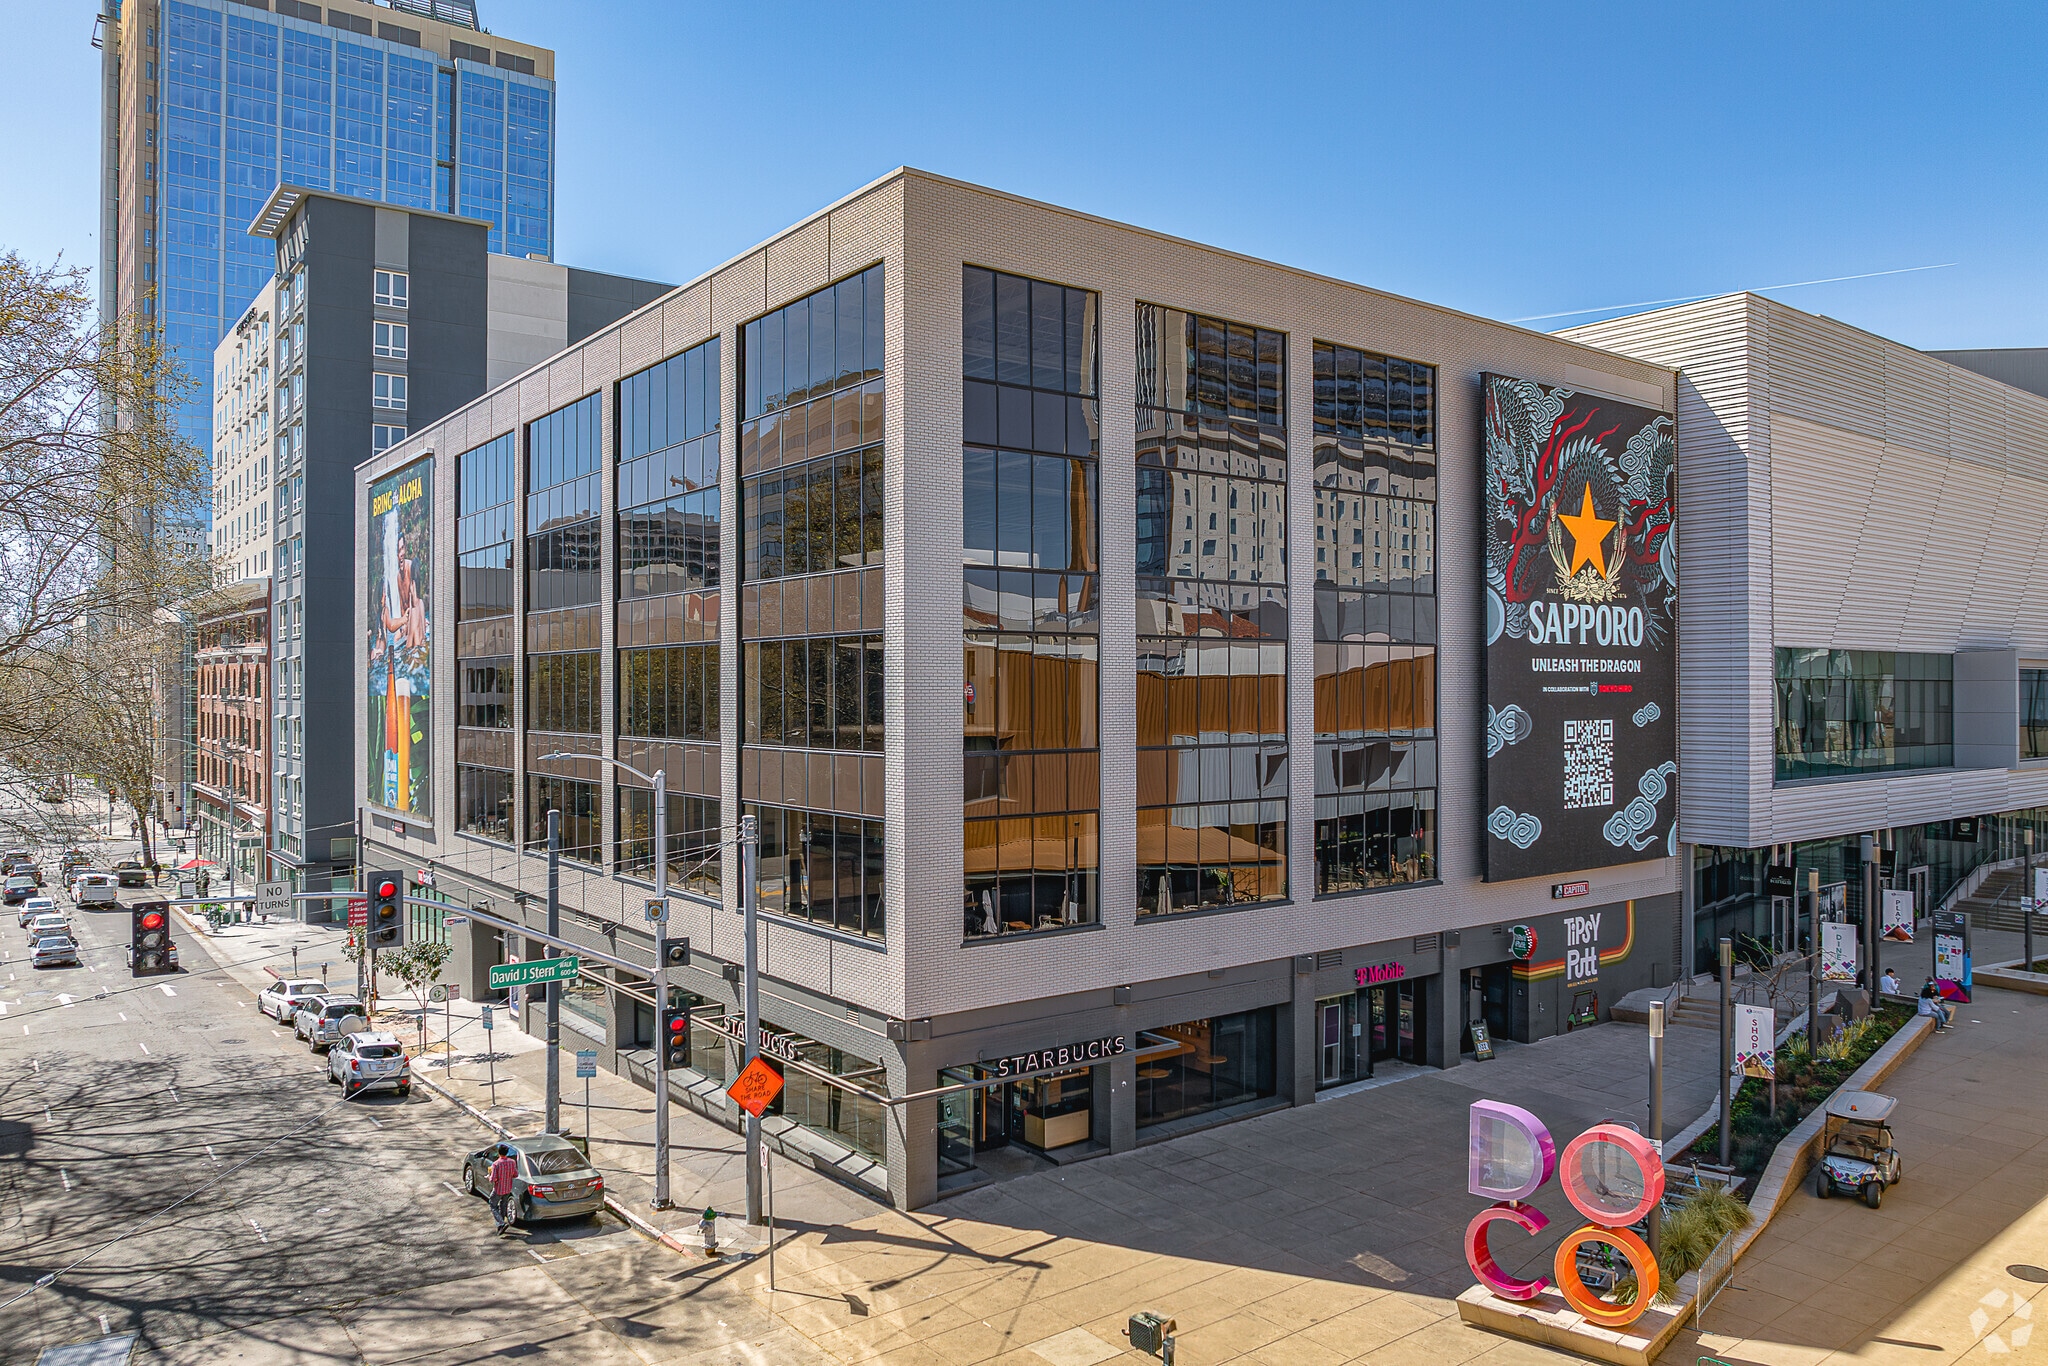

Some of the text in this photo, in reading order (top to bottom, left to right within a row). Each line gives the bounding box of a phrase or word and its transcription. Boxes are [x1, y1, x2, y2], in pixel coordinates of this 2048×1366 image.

[373, 491, 392, 517] BRING
[398, 477, 422, 505] ALOHA
[1528, 600, 1644, 647] SAPPORO
[1531, 658, 1641, 673] UNLEASH THE DRAGON
[266, 887, 283, 897] NO
[1563, 883, 1588, 896] CAPITOL
[259, 899, 290, 911] TURNS
[1567, 946, 1598, 980] Putt
[492, 968, 519, 984] David
[522, 968, 527, 980] J
[529, 967, 555, 979] Stern
[1751, 1019, 1759, 1049] SHOP
[998, 1037, 1125, 1077] STARBUCKS
[740, 1090, 771, 1101] THE ROAD
[745, 1084, 765, 1093] SHARE
